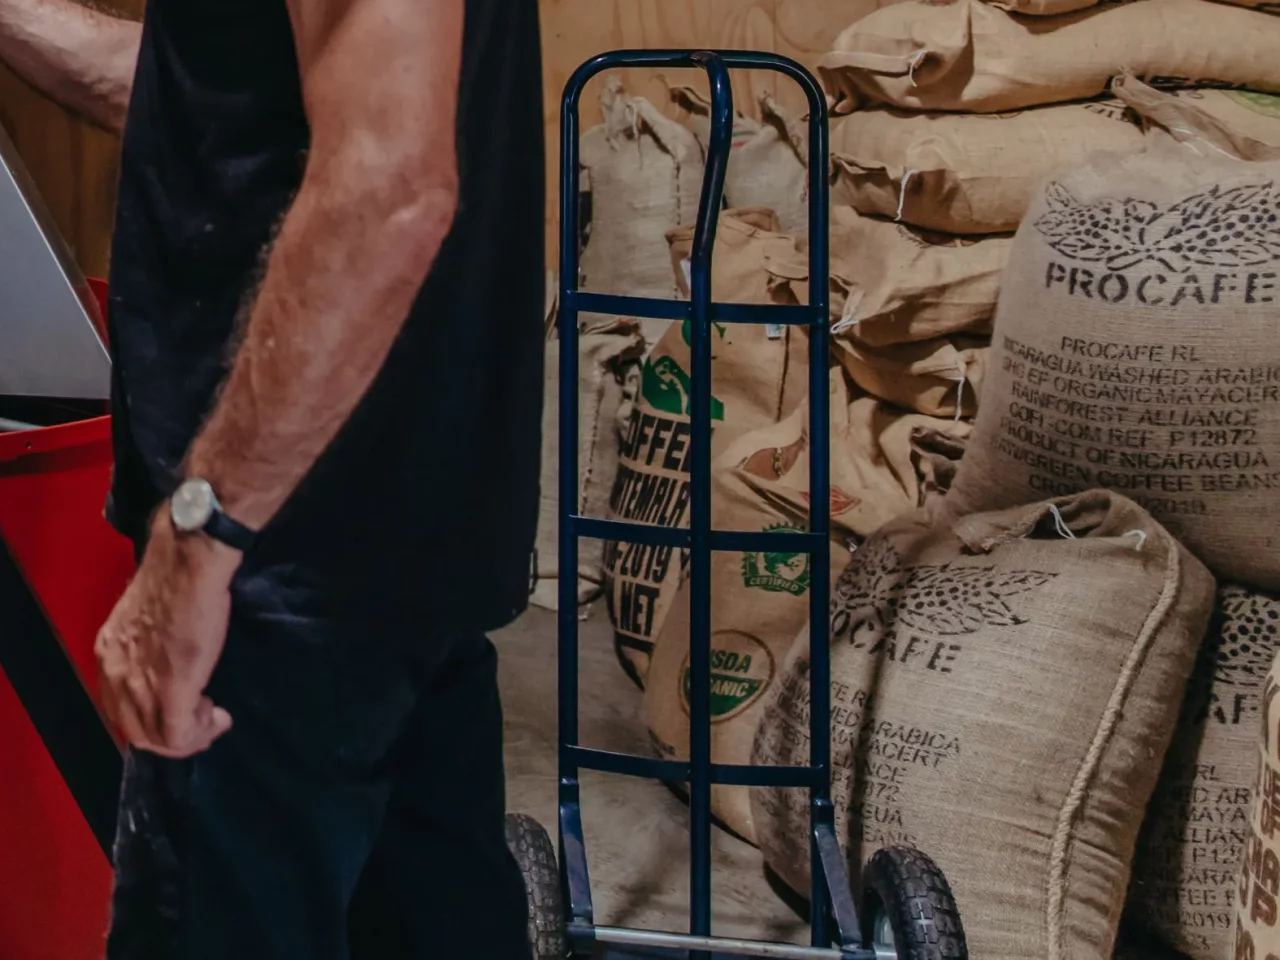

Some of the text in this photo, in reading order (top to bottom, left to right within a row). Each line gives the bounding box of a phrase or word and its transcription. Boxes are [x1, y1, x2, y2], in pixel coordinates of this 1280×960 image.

[1046, 262, 1277, 304] PROCAFE
[1061, 336, 1200, 362] PROCAFE RL
[1012, 381, 1258, 427] RAINFOREST ALLIANCE
[1001, 417, 1082, 458] PRODUCT
[1086, 446, 1115, 465] OF
[1119, 450, 1269, 471] NICARAGUA
[1109, 428, 1154, 448] REF
[1098, 471, 1194, 492] COFFEE
[620, 581, 660, 637] NET
[710, 649, 752, 673] SDA
[710, 680, 750, 698] ANIC
